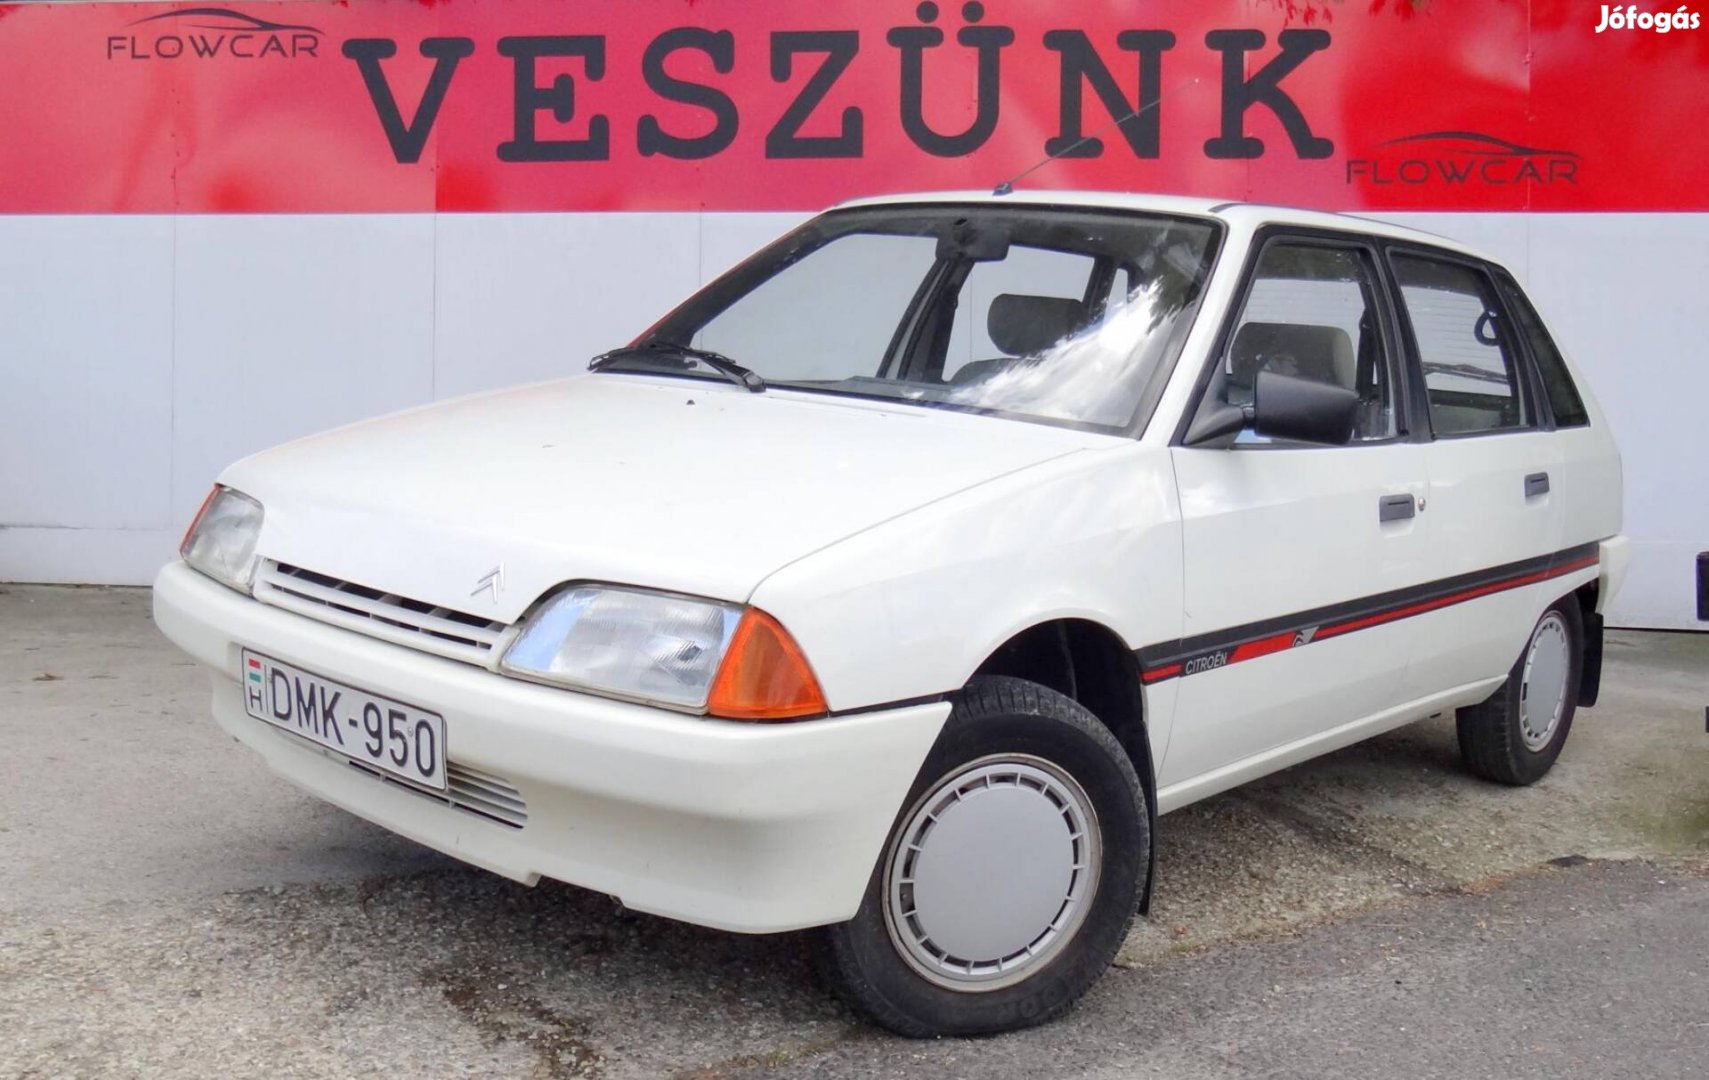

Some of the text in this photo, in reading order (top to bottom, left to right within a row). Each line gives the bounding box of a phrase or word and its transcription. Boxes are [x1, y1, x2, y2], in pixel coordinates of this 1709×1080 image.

[108, 35, 319, 60] FLOWCAR
[343, 1, 1334, 163] VESZÜNK
[1347, 160, 1578, 184] FLOWCAR
[1185, 651, 1228, 675] CITROËN
[249, 686, 263, 711] H
[271, 667, 436, 777] DMK-950
